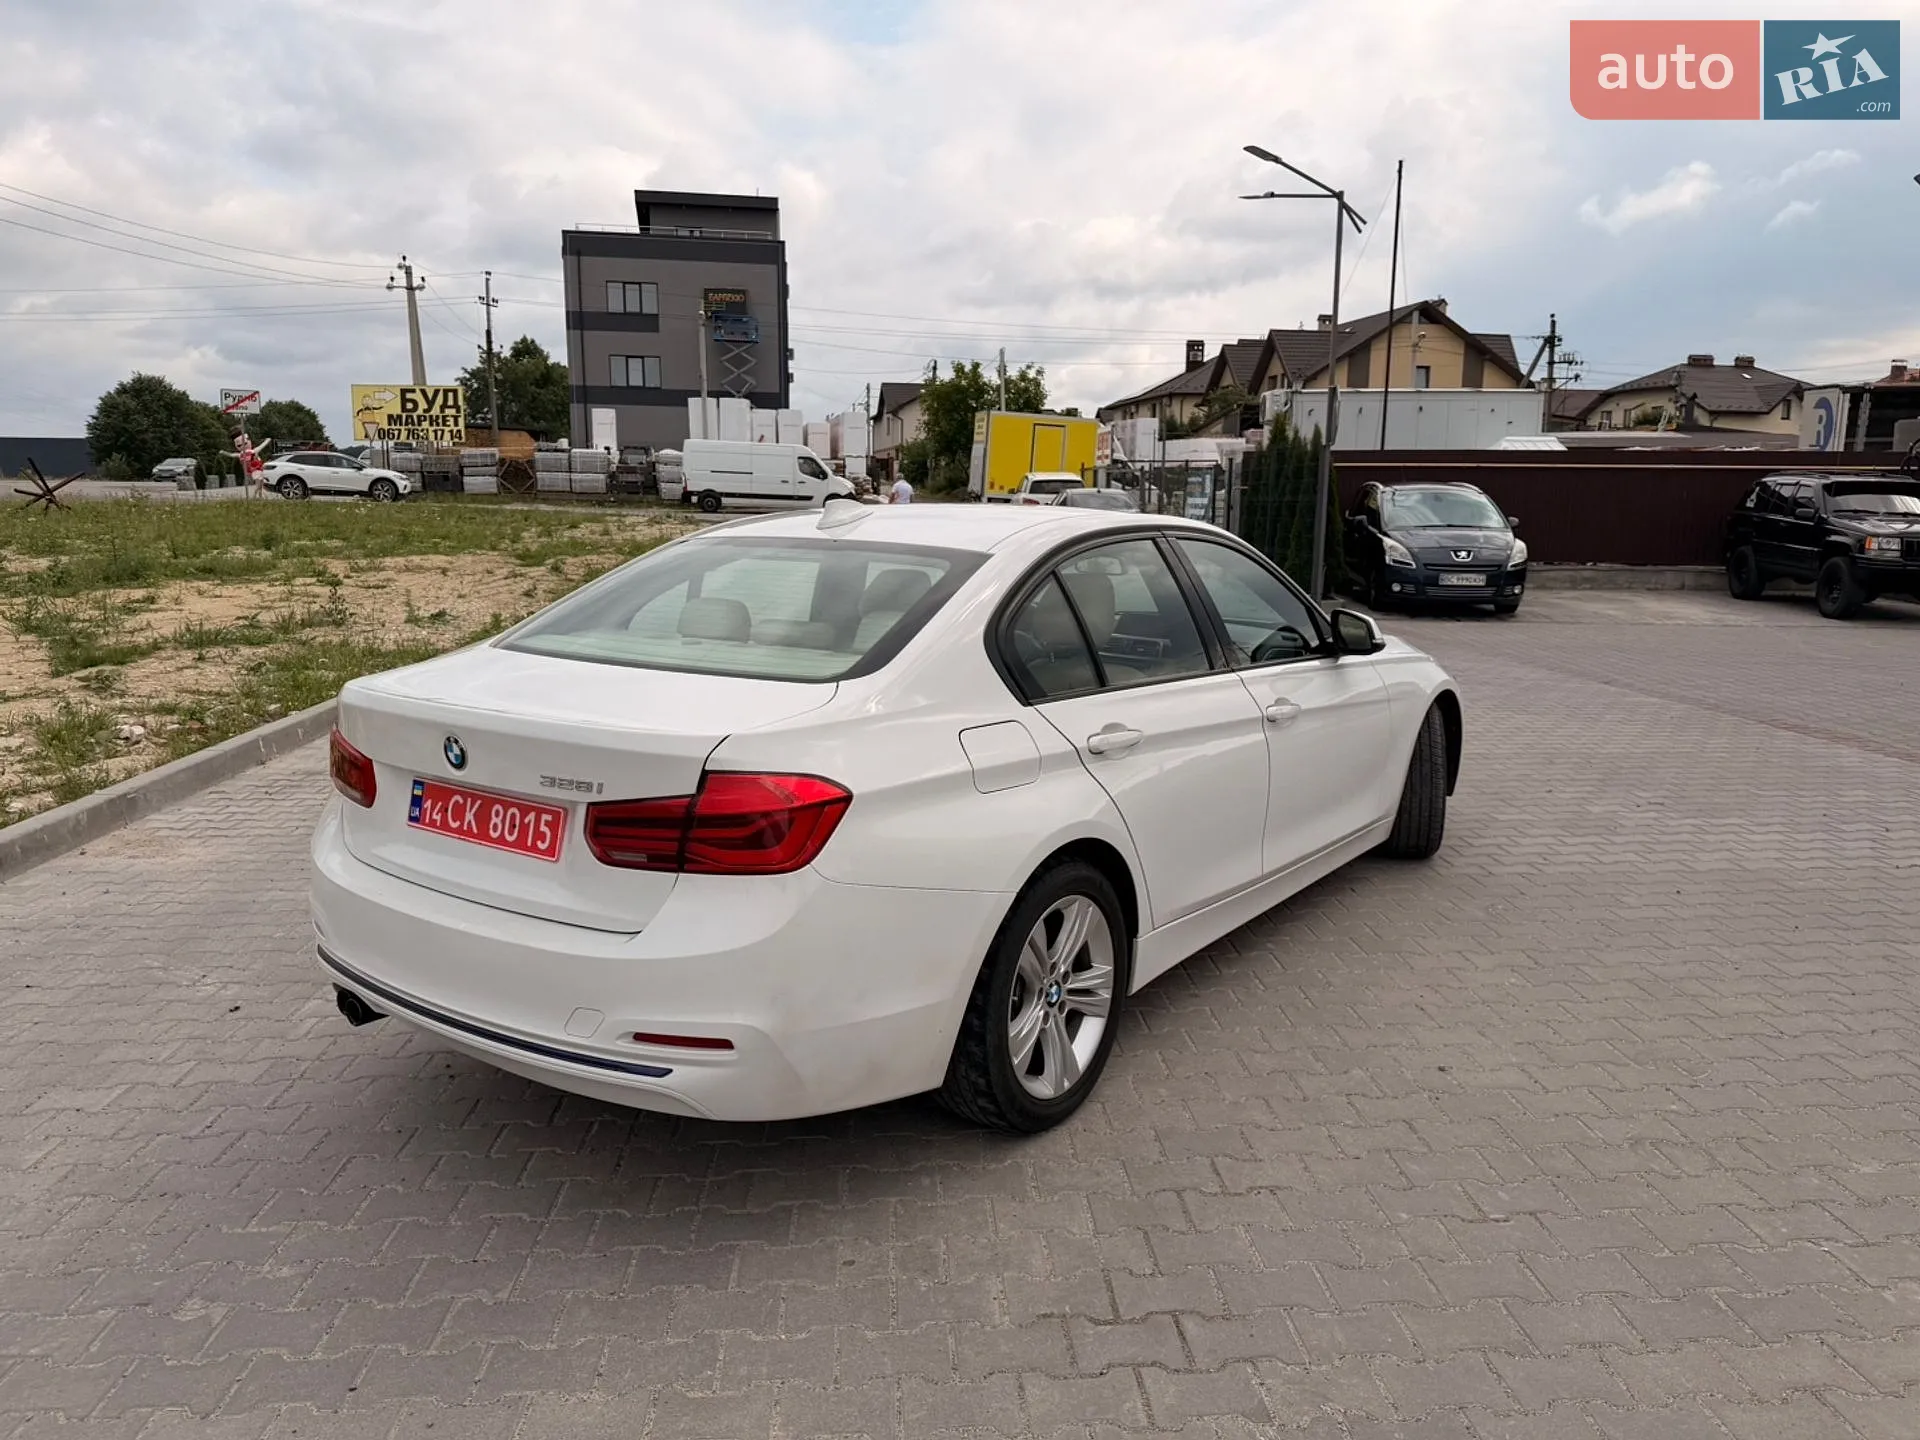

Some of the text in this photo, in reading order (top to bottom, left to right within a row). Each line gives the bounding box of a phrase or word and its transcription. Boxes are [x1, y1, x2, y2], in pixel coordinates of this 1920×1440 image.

[399, 388, 462, 414] БУД
[387, 413, 462, 428] МАРКЕТ
[377, 427, 463, 441] 067 763 17 14
[489, 803, 553, 850] 8015
